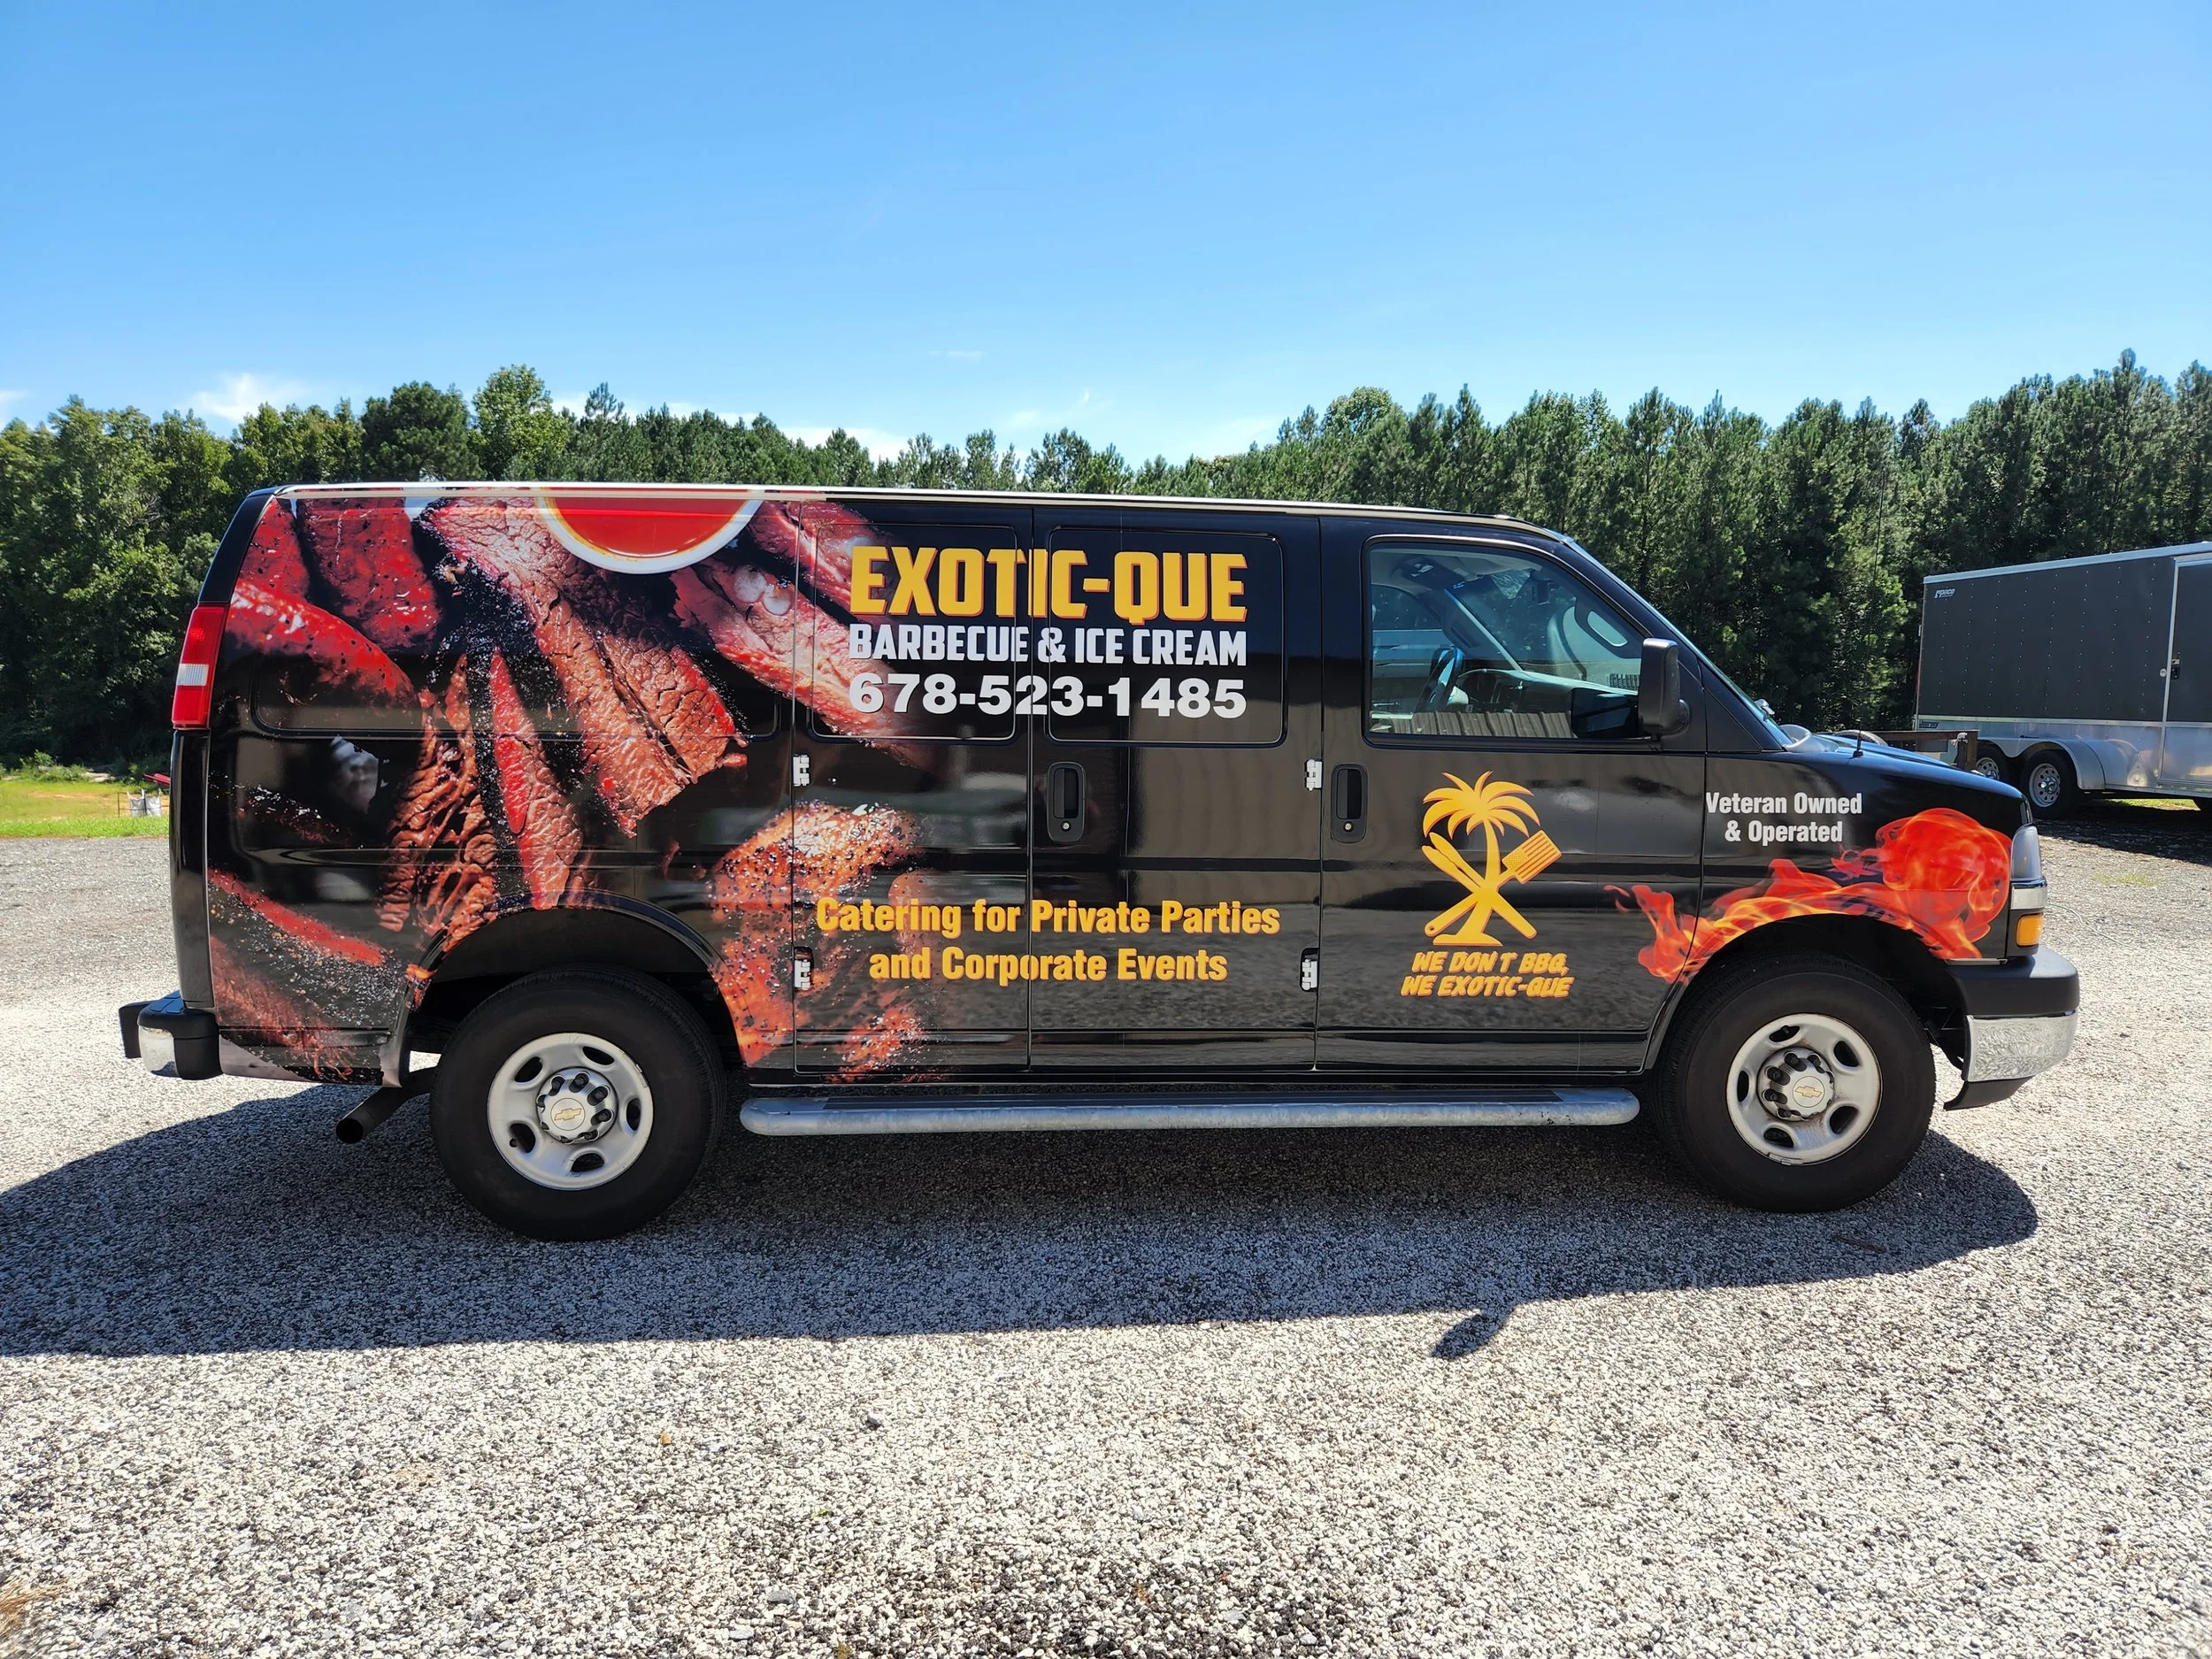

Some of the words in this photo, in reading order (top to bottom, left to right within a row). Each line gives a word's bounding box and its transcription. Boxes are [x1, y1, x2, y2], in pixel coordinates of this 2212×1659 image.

[850, 546, 1248, 625] EXOTIC-QUE
[849, 623, 1028, 663] BARBECUE
[1038, 626, 1066, 663] &
[1075, 628, 1123, 664] ICE
[1133, 628, 1247, 666] CREAM
[849, 673, 1247, 718] 678-523-1485
[1706, 792, 1787, 814] Veteran
[1793, 792, 1862, 814] Owned
[1725, 819, 1741, 841] &
[1748, 820, 1843, 846] Operated
[816, 896, 962, 939] Catering
[972, 899, 1021, 932] for
[1031, 899, 1149, 933] Private
[1161, 900, 1281, 934] Parties
[868, 947, 930, 980] and
[941, 948, 1107, 987] Corporate
[1117, 948, 1229, 981] Events
[1411, 950, 1448, 973] WE
[1401, 974, 1438, 997] WE
[1437, 975, 1576, 998] EXOTIC-QUE
